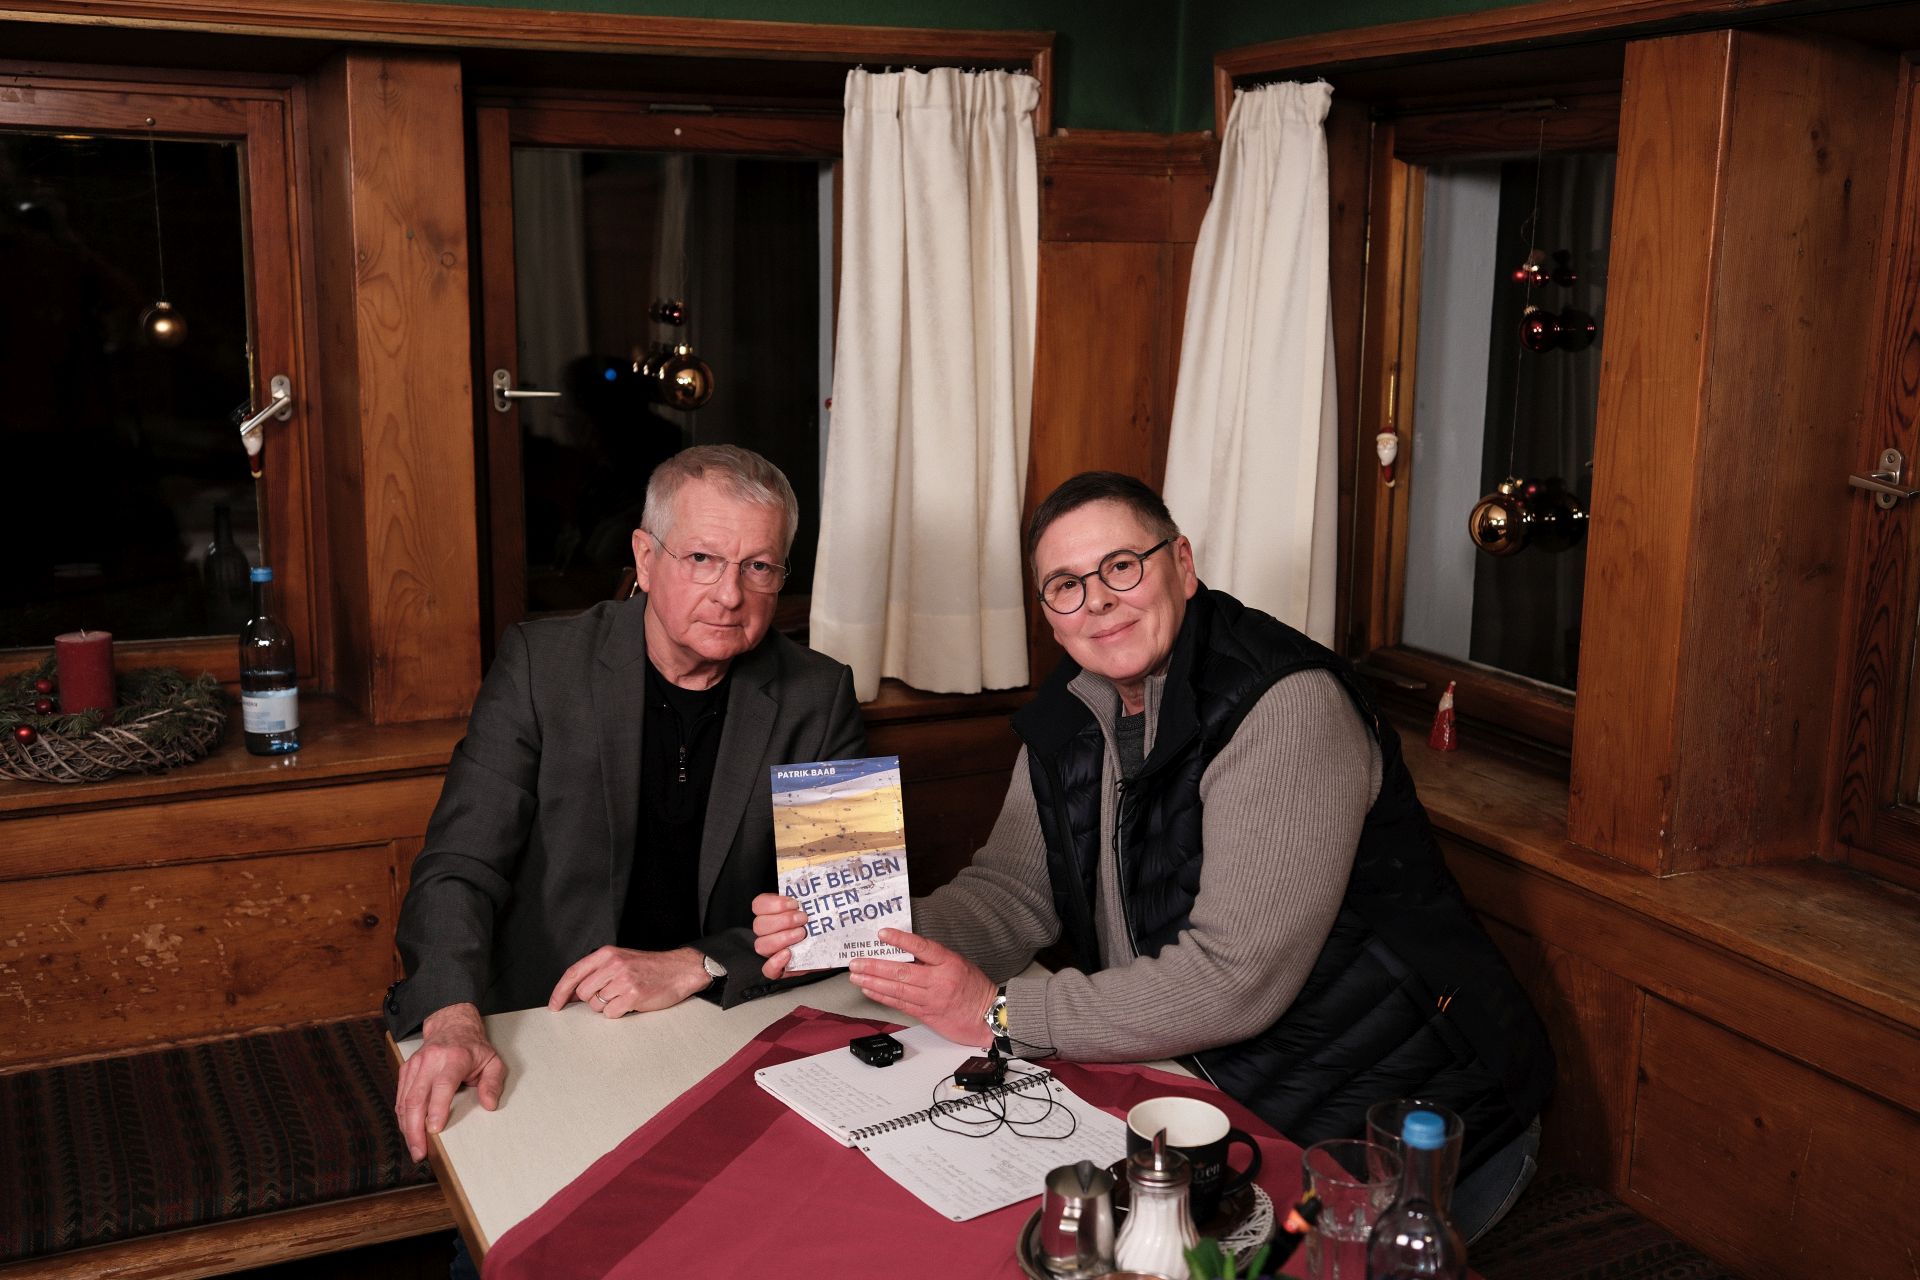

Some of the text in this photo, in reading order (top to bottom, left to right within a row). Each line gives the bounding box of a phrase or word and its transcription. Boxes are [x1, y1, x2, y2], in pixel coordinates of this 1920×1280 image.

[777, 767, 836, 779] PATRIK BAAB
[785, 856, 901, 899] AUF BEIDEN
[801, 887, 860, 917] EITEN
[807, 896, 904, 938] ER FRONT
[838, 951, 848, 959] IN
[850, 950, 865, 958] DIE
[843, 940, 871, 950] MEINE
